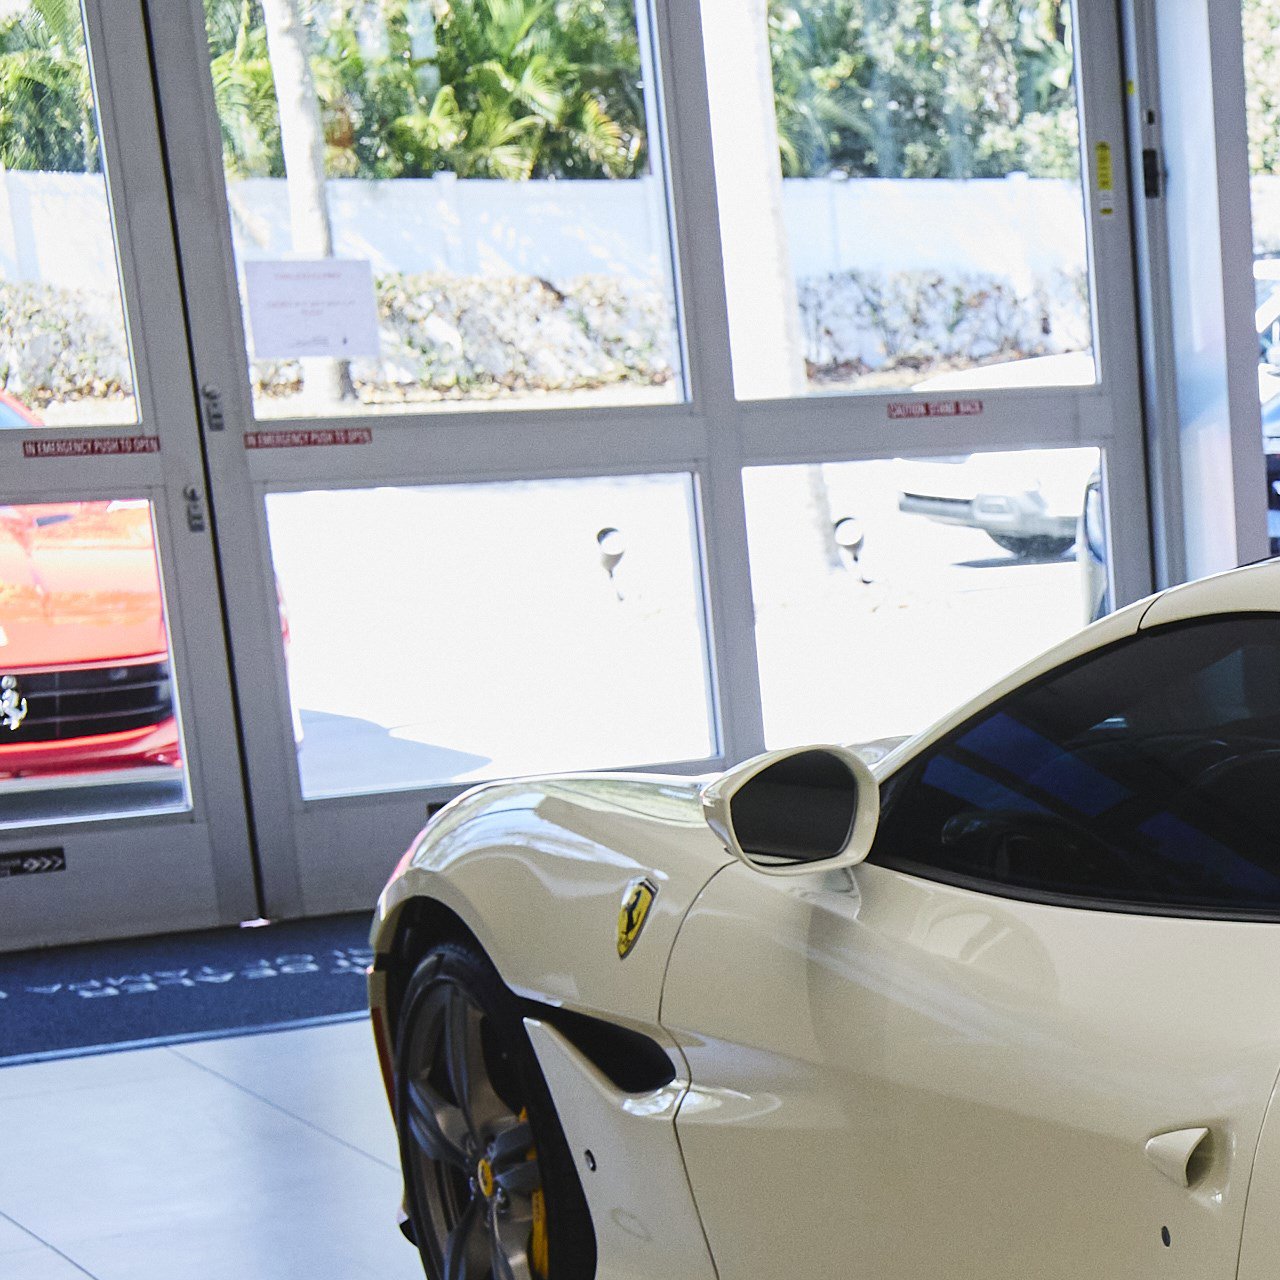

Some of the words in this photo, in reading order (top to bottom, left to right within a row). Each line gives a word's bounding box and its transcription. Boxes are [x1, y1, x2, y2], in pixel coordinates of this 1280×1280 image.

[39, 440, 92, 454] EMERGENCY
[94, 439, 119, 453] PUSH
[133, 437, 159, 452] OPEN
